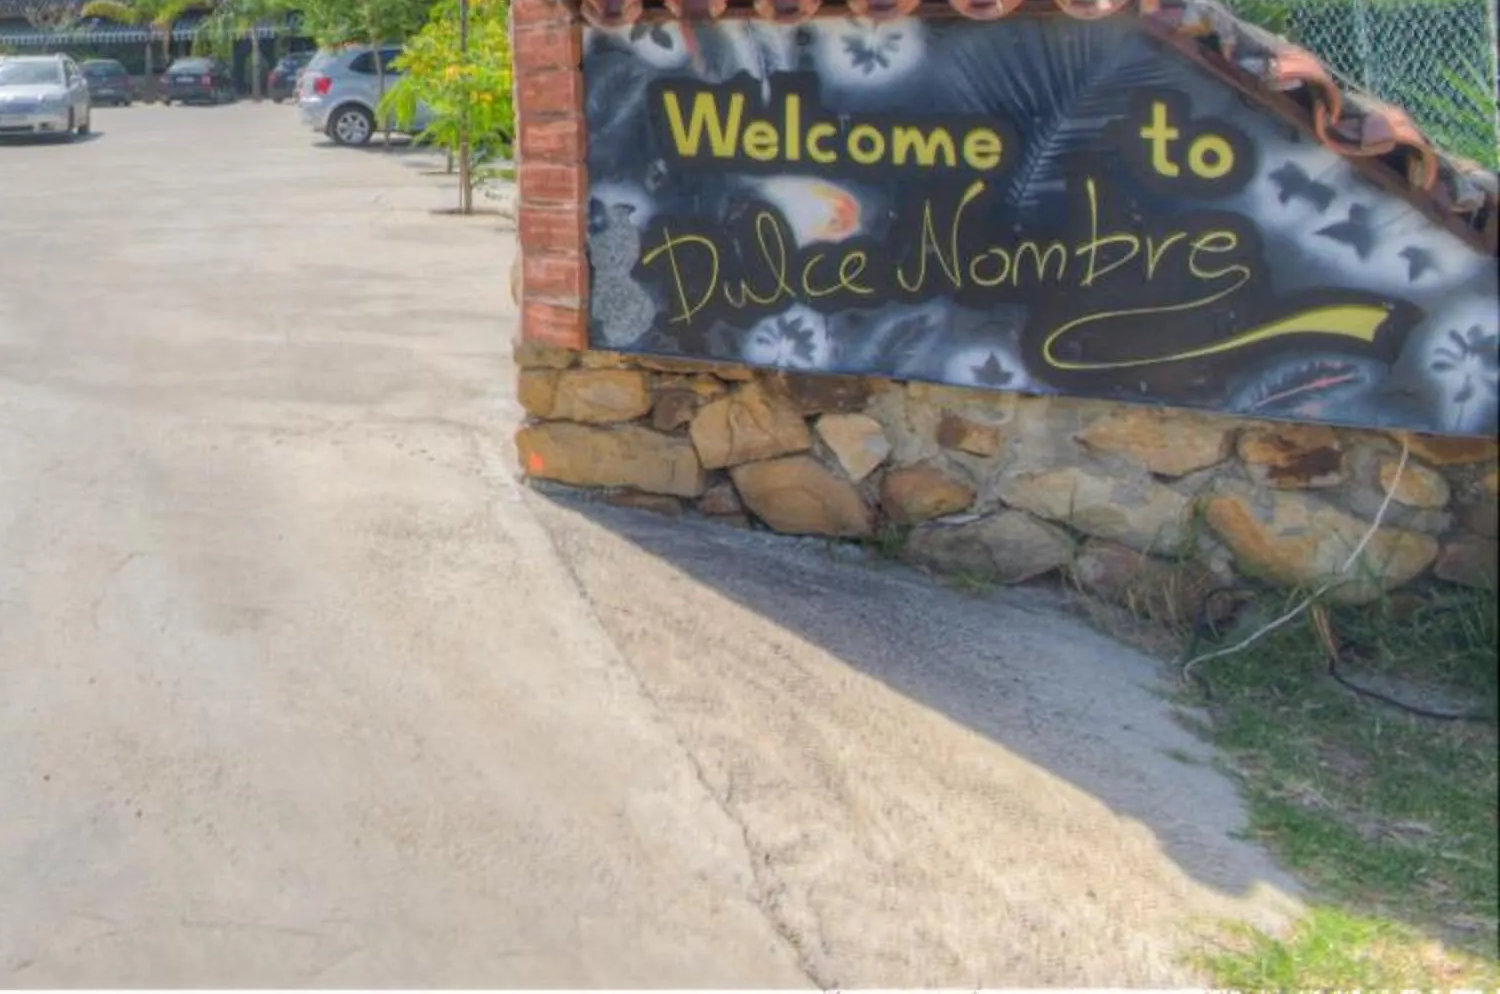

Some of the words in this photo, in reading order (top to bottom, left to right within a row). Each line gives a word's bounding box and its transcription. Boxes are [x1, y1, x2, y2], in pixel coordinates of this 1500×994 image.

[663, 91, 1004, 169] Welcome
[1140, 100, 1235, 178] to
[642, 212, 875, 325] Dulce
[896, 179, 1252, 304] Nombre
